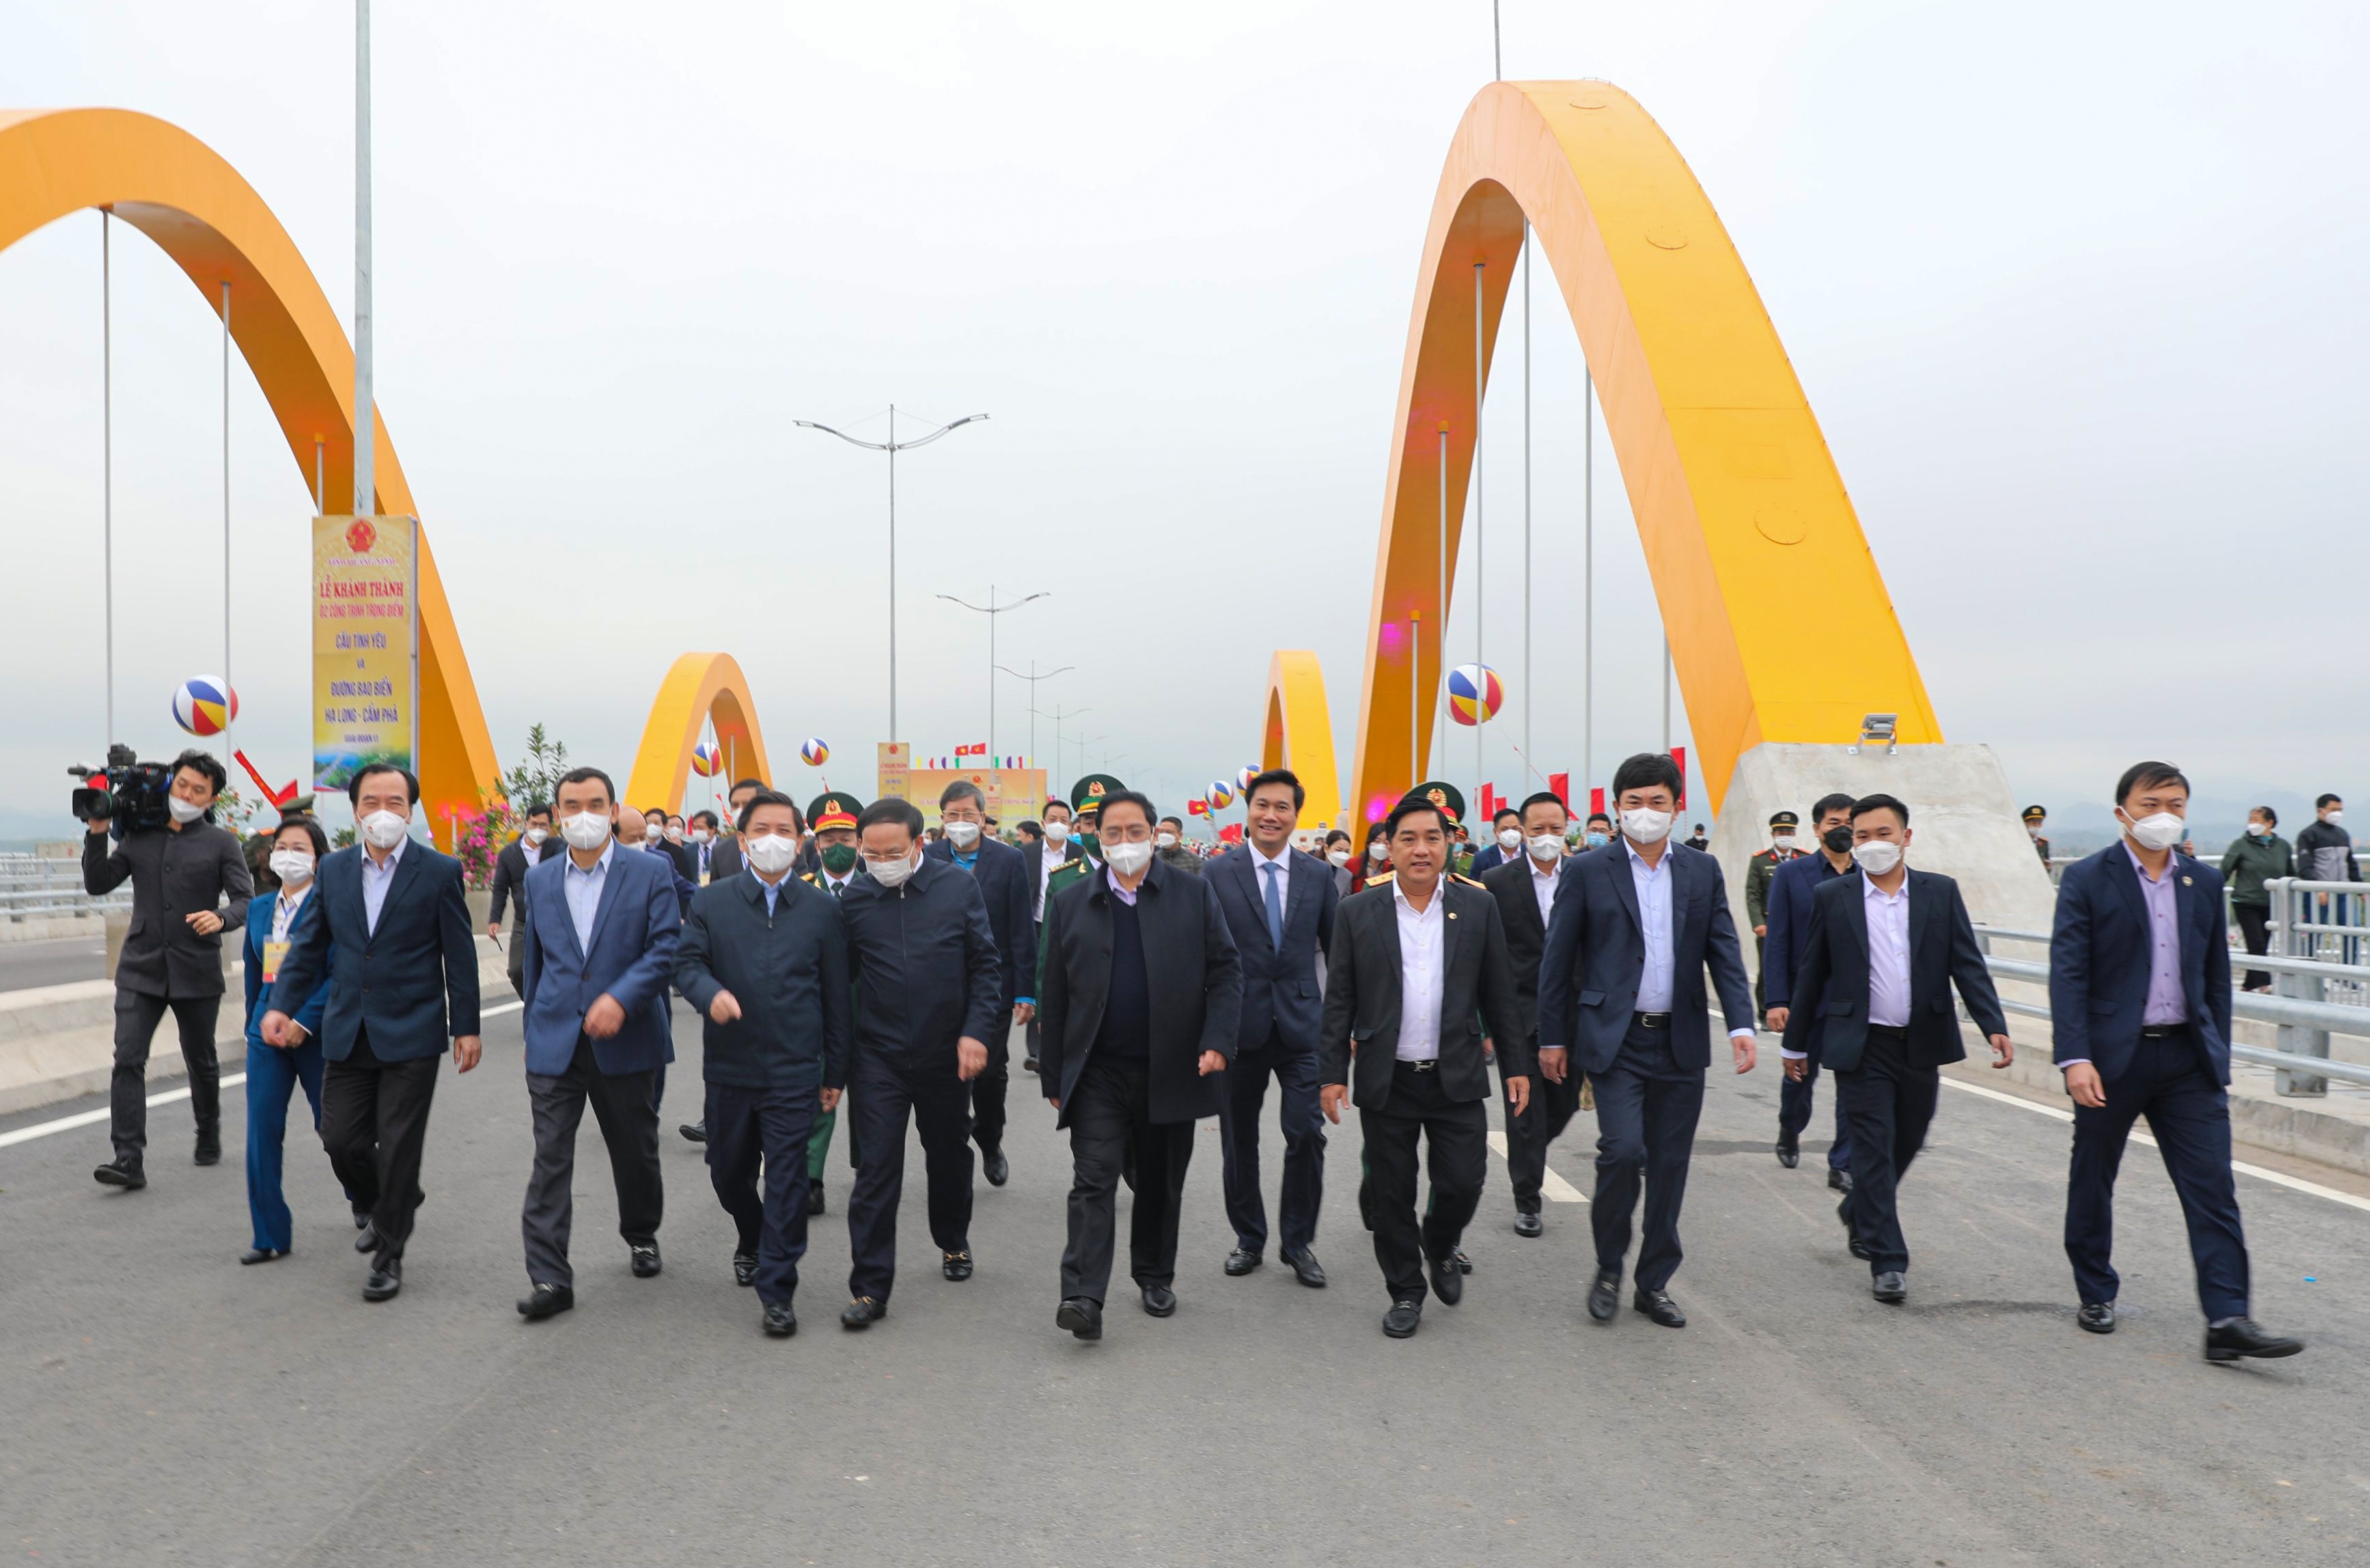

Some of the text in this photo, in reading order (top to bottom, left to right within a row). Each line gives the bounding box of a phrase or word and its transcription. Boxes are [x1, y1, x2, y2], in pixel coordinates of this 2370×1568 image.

[334, 577, 366, 598] KHÁNH
[370, 577, 403, 598] THÀNH
[337, 708, 357, 723] LONG
